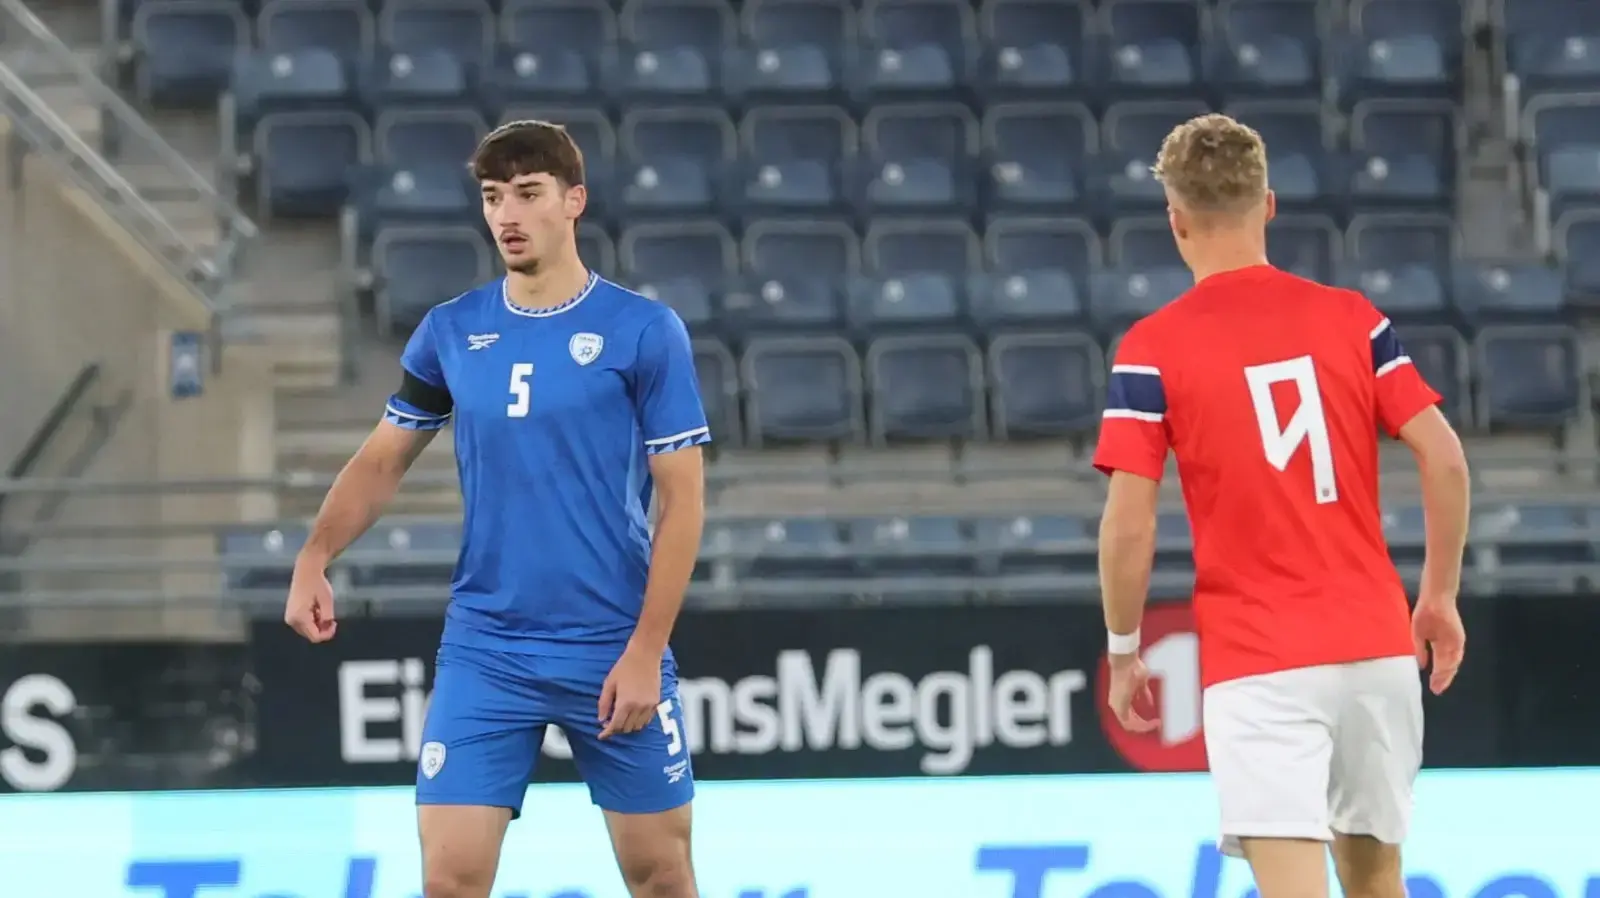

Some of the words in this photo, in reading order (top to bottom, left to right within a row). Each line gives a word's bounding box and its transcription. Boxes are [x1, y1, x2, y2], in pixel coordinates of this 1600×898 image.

[507, 363, 534, 418] 5
[1243, 354, 1339, 504] 9
[657, 698, 682, 757] 5
